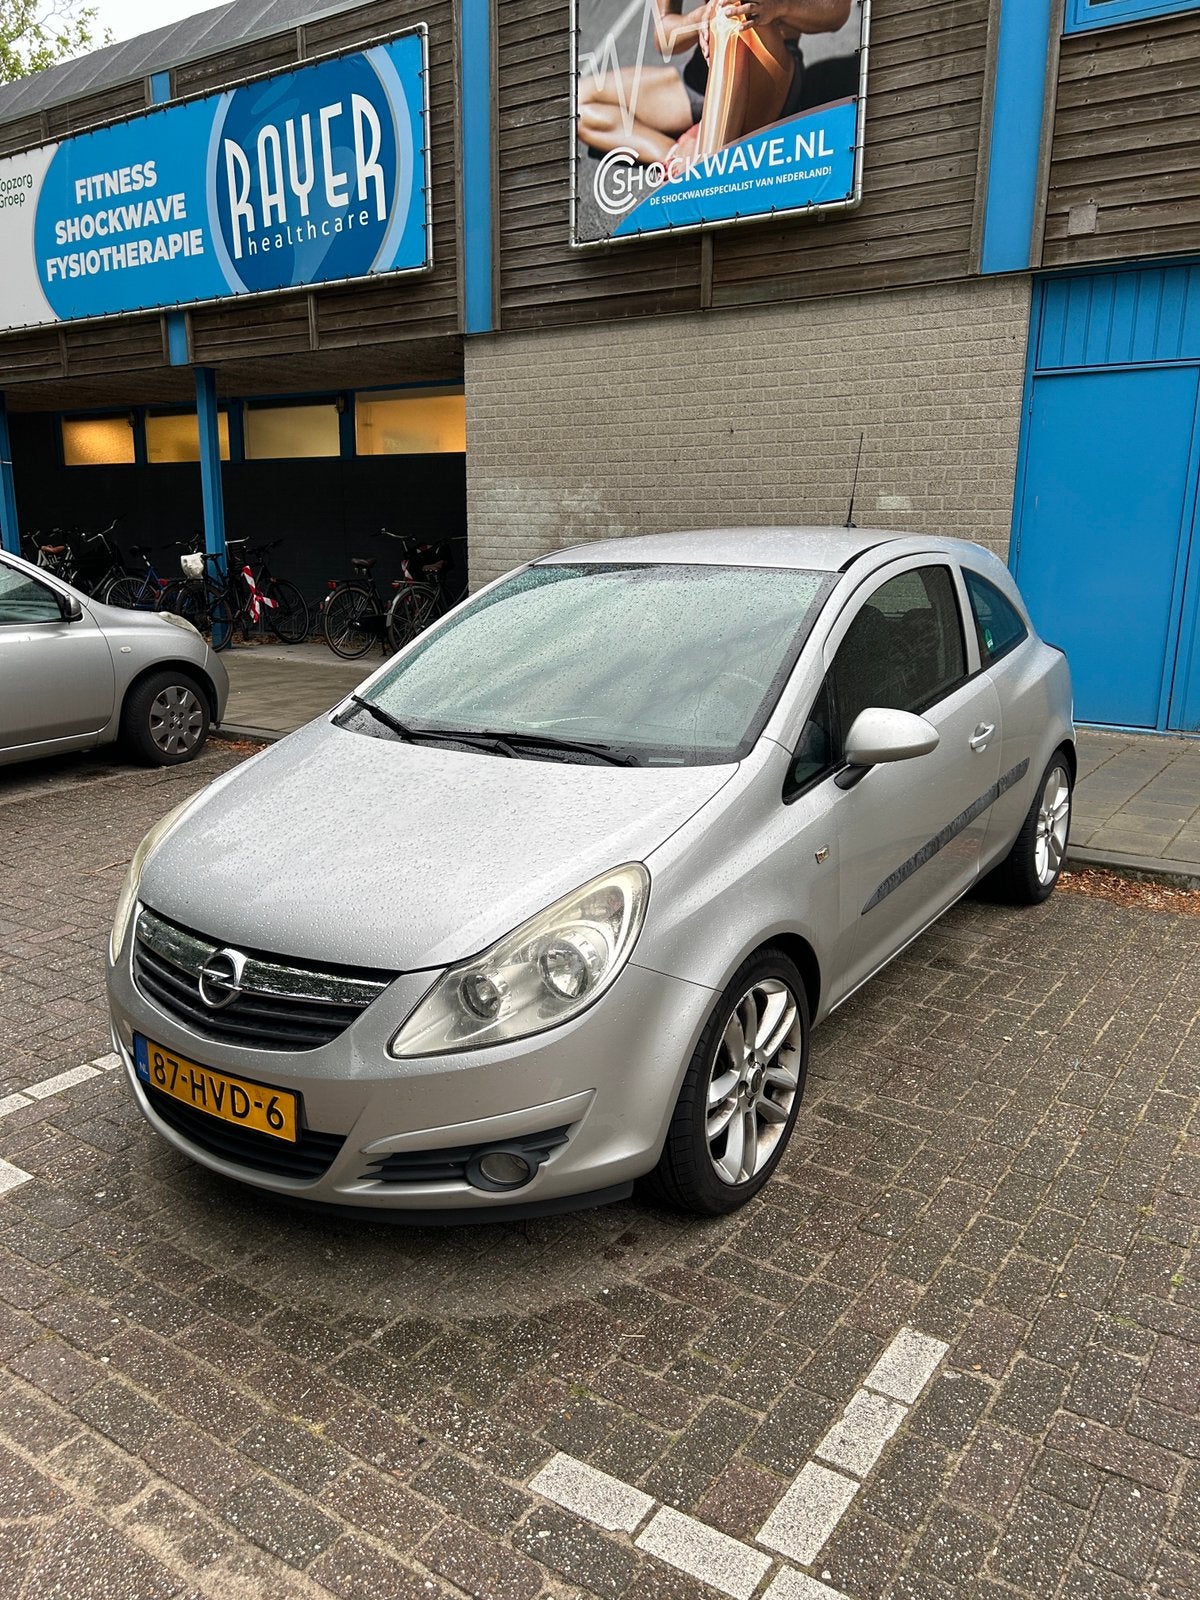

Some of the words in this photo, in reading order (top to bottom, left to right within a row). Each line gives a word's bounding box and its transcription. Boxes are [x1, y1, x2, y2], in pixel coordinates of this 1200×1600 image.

[0, 174, 33, 194] opzorg
[74, 160, 158, 205] FITNESS
[224, 93, 387, 259] RAYER
[612, 129, 834, 195] SHOCKWAVE.NL
[650, 196, 661, 206] DE
[661, 180, 754, 204] SHOCKWAVESPECIALIST
[755, 177, 774, 187] VAN
[775, 166, 832, 185] NEDERLAND!
[55, 193, 187, 245] SHOCKWAVE
[248, 211, 369, 256] healthcare
[46, 228, 204, 282] FYSIOTHERAPIE
[139, 1061, 149, 1075] NL
[153, 1051, 285, 1131] 87-HVD-6
